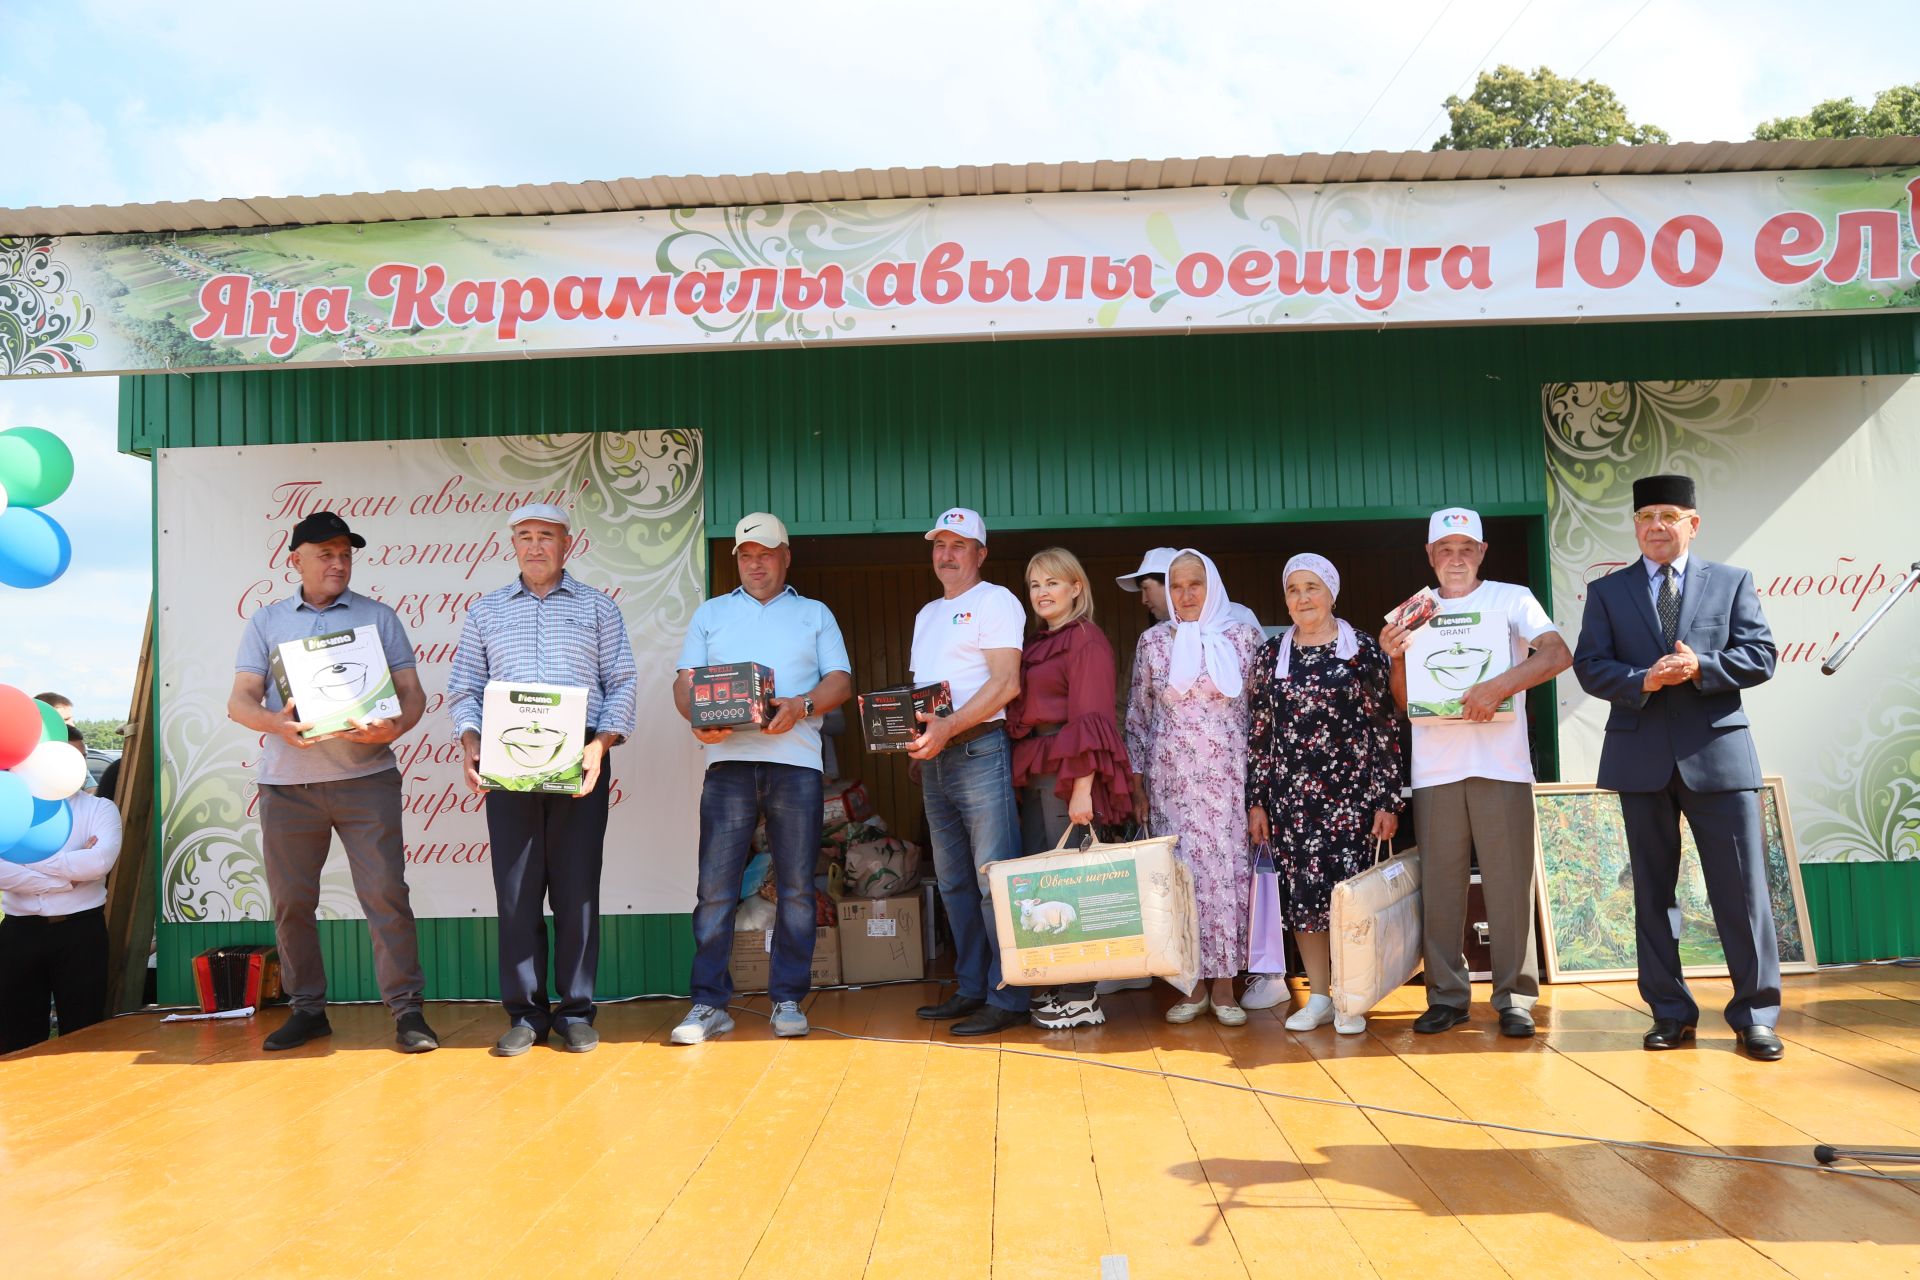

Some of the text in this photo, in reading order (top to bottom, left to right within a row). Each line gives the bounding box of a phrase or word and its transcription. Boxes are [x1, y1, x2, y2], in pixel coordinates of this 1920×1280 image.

[191, 274, 352, 357] Яңа
[367, 262, 847, 341] Карамалы
[865, 240, 1157, 306] авылы
[1174, 243, 1494, 312] оешуга
[1534, 214, 1725, 290] 100
[1440, 628, 1471, 637] GRANIT
[519, 706, 550, 715] GRANIT
